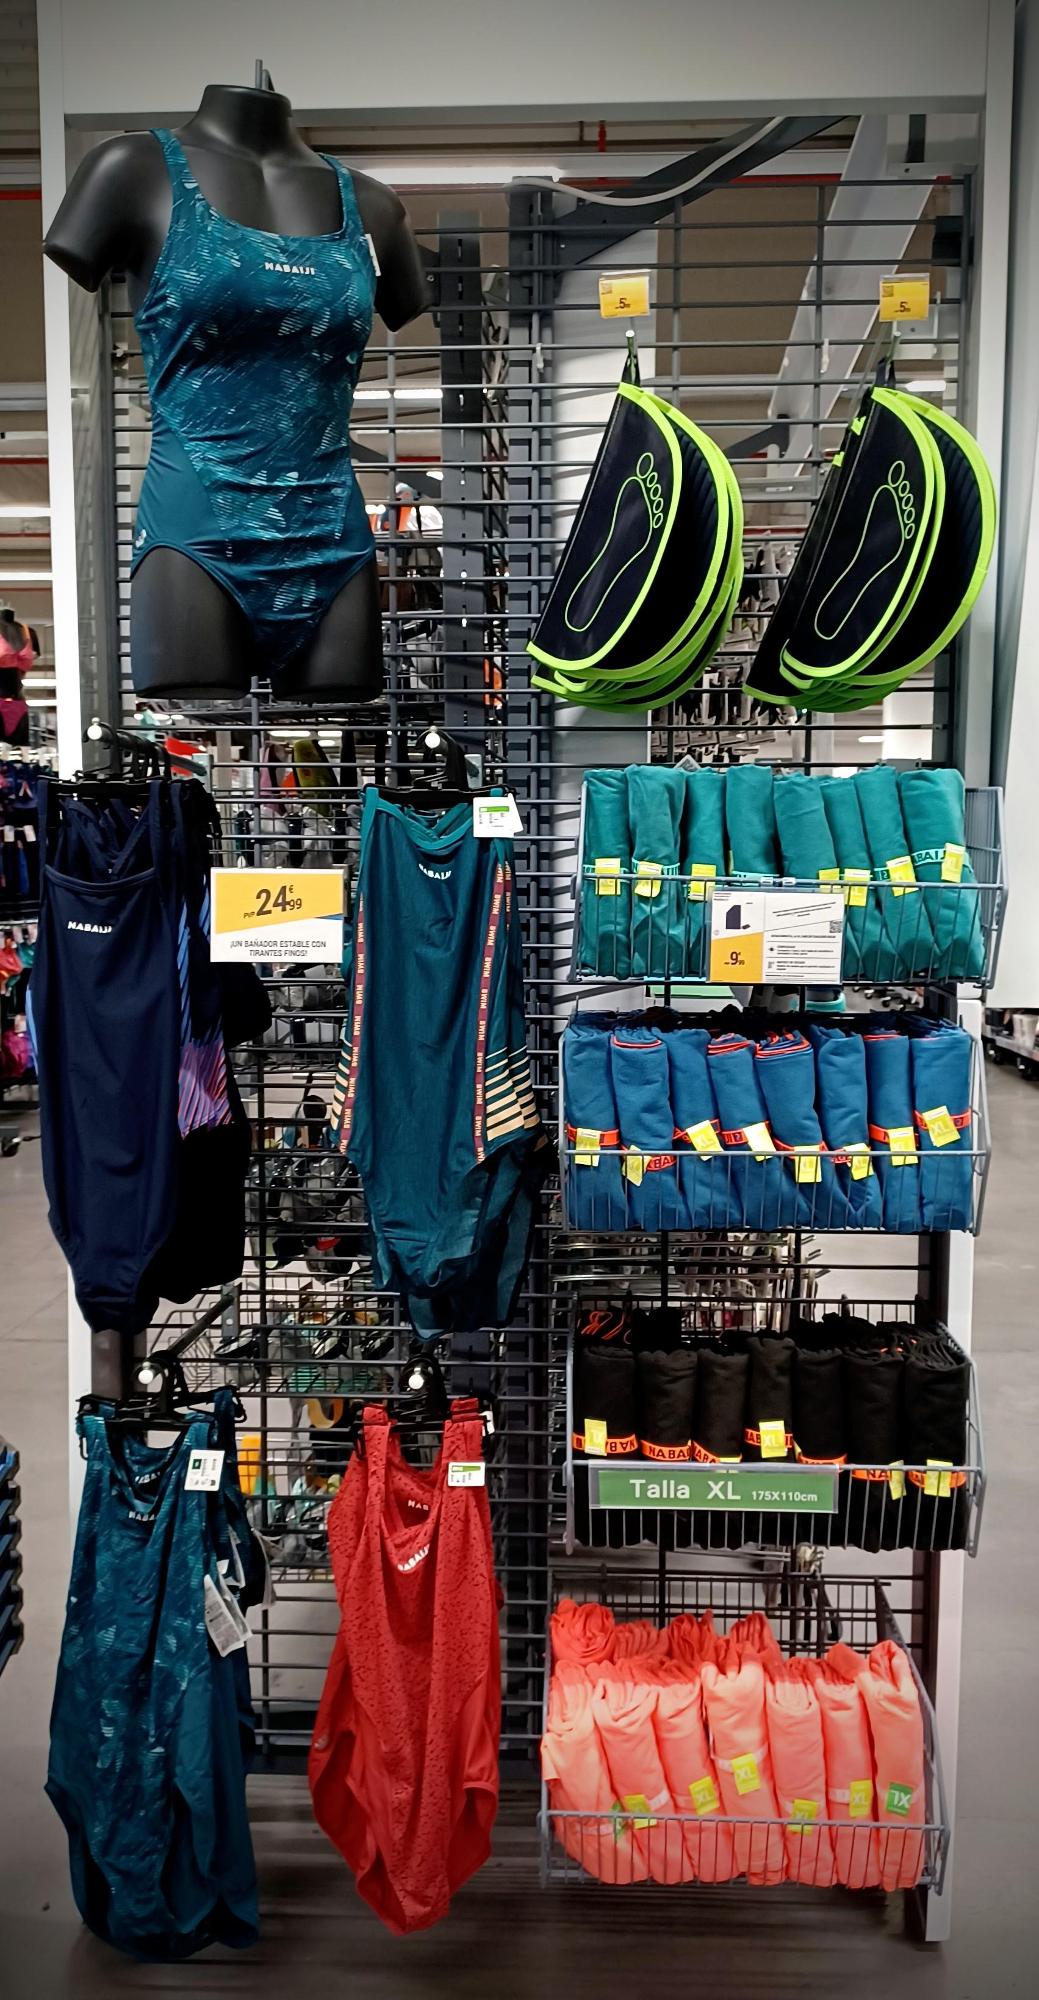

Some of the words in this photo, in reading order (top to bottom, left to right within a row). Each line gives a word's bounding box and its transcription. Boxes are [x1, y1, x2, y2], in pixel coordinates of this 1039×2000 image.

[255, 885, 290, 916] 24
[244, 939, 278, 948] BAÑADOR
[279, 940, 310, 948] ESTABLE
[311, 940, 327, 948] CON
[249, 949, 283, 957] TIRANTES
[629, 1479, 690, 1499] Talla
[707, 1480, 742, 1500] XL
[752, 1490, 818, 1502] 175X110cm
